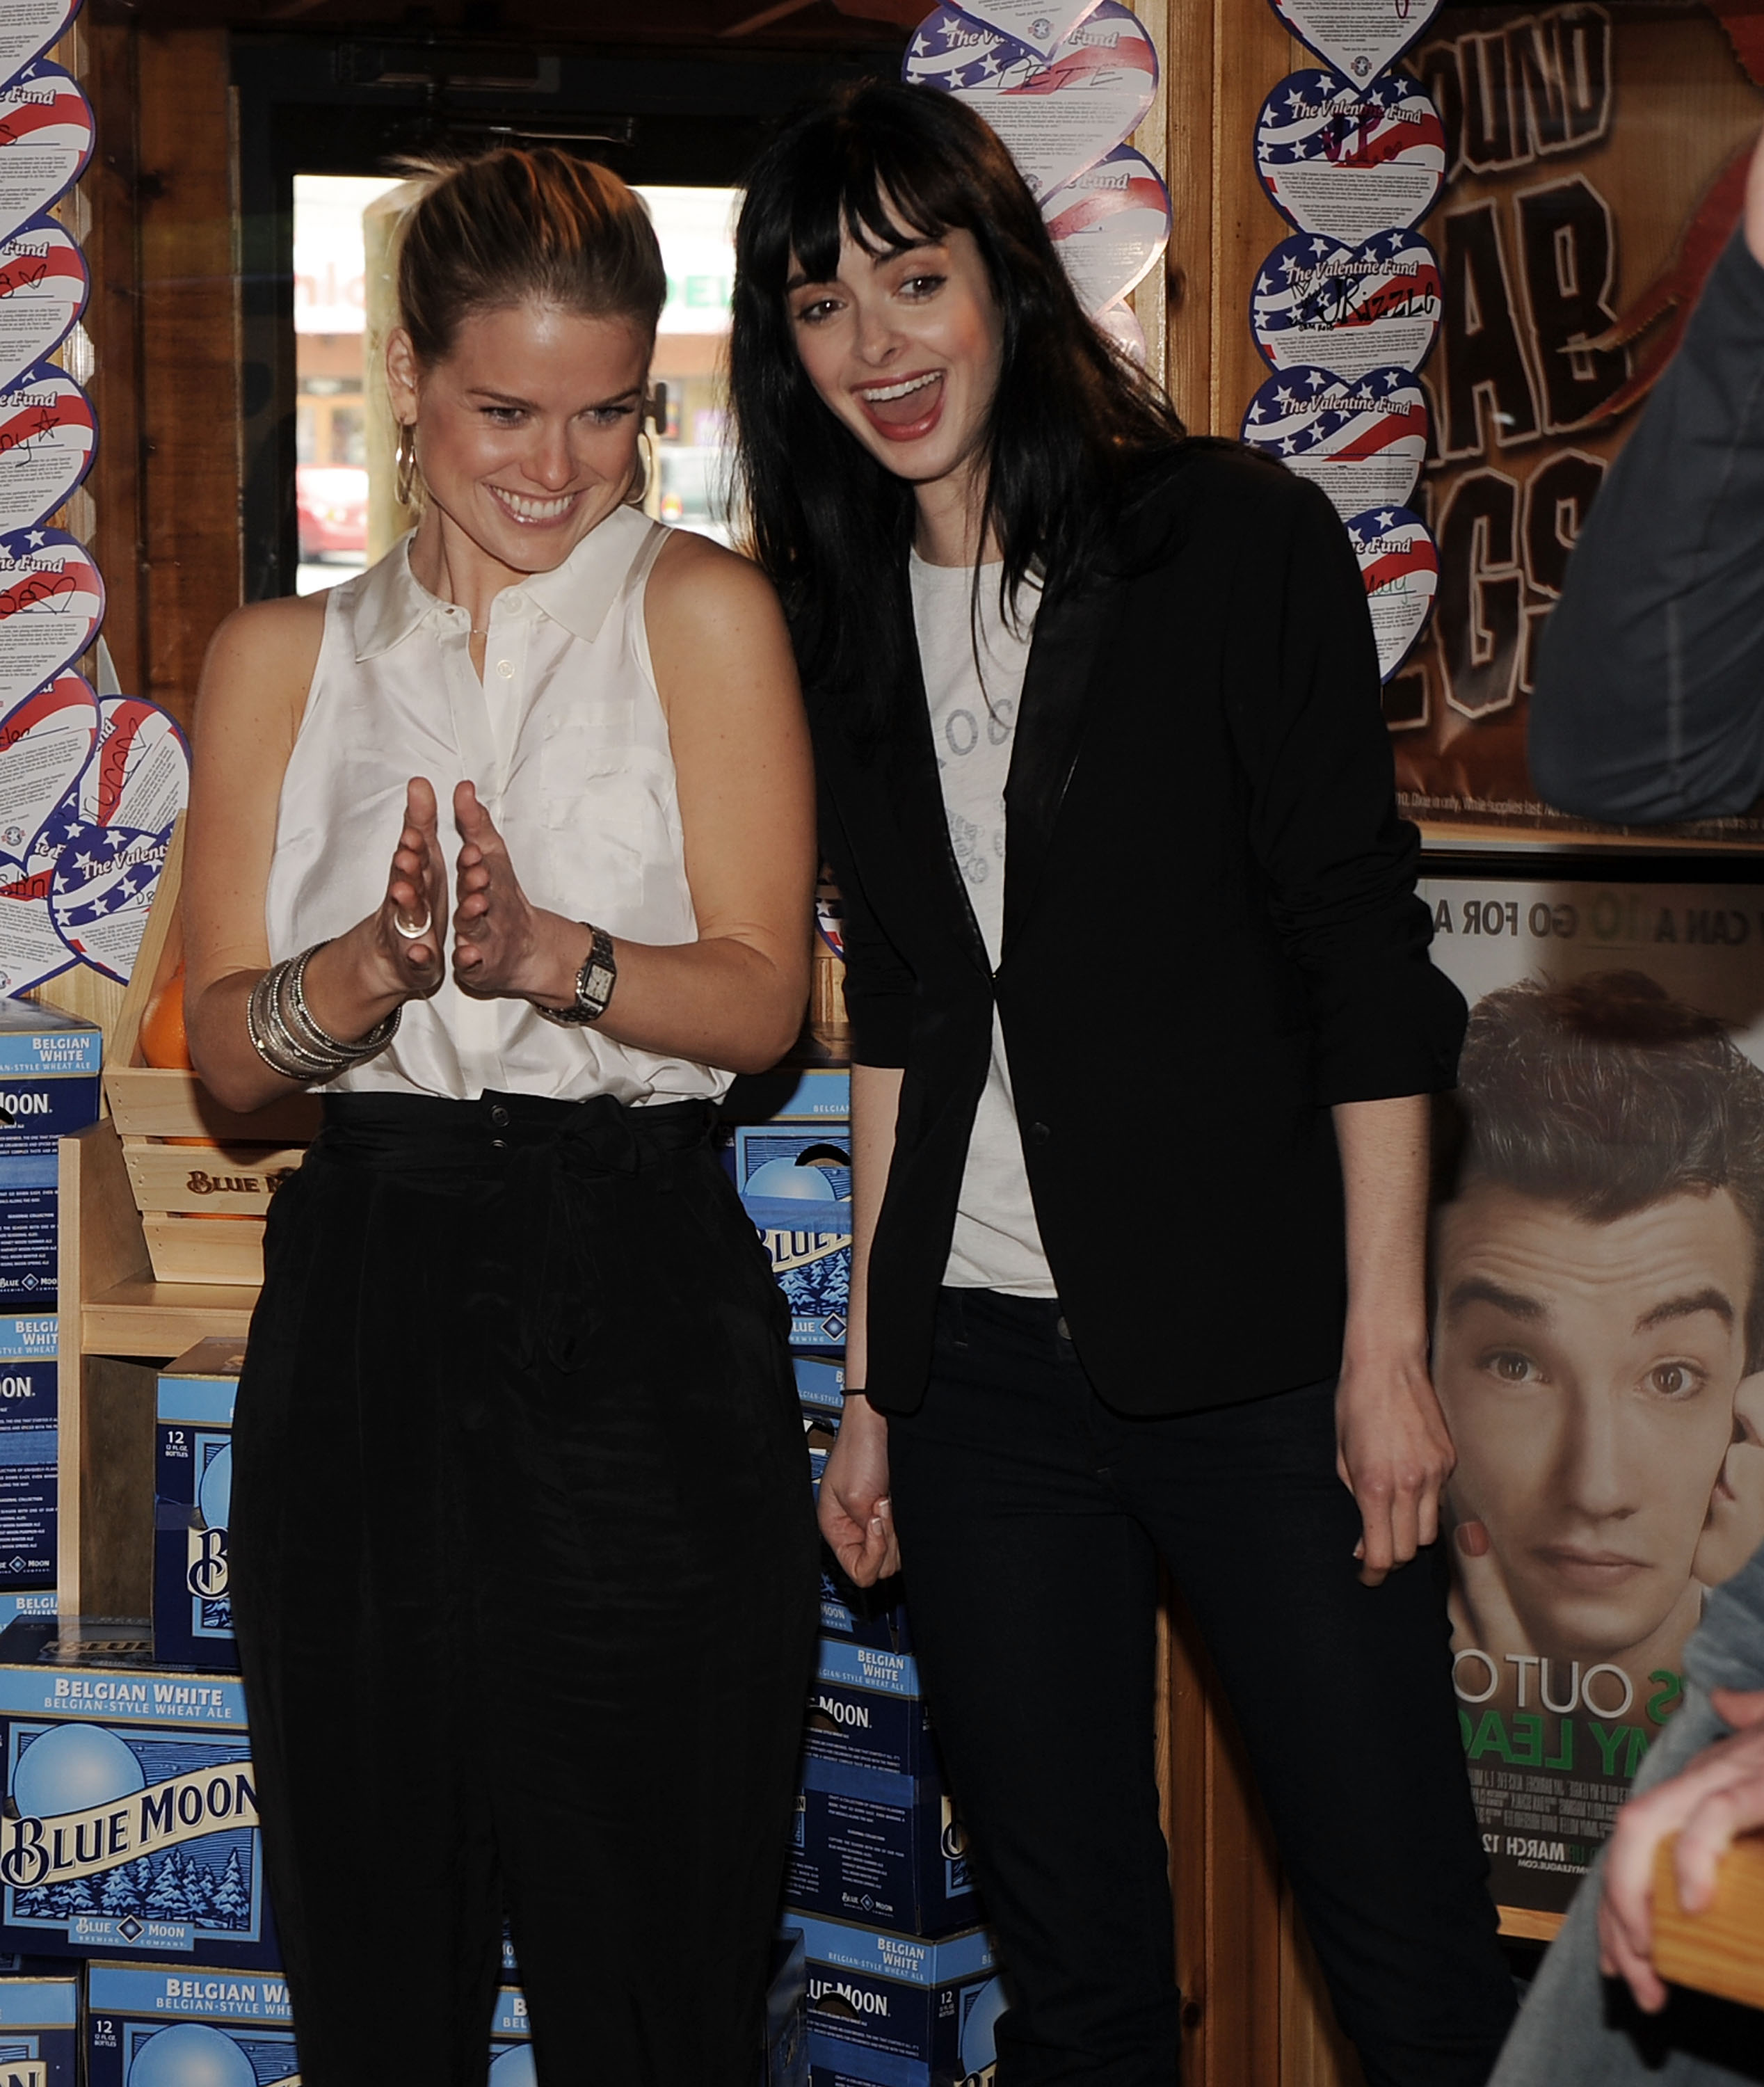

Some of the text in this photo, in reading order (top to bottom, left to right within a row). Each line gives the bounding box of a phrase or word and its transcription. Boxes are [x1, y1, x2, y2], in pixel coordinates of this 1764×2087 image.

[946, 30, 978, 48] The
[1068, 26, 1120, 49] Fund
[9, 85, 56, 106] Fund
[1292, 98, 1423, 126] The Valentine Fund
[3, 239, 49, 258] Fund
[1286, 257, 1420, 285] The Valentine Fund
[11, 389, 57, 408] Fund
[1280, 393, 1413, 416] The Valentine Fund
[1369, 536, 1413, 554] Fund
[19, 554, 65, 573] Fund
[82, 846, 169, 880] The Valent
[33, 1037, 90, 1050] BELGIAN
[40, 1050, 83, 1062] WHITE
[42, 1062, 72, 1071] WHEAT
[187, 1170, 261, 1195] BLUE
[40, 1277, 57, 1286] MOO
[793, 1322, 815, 1333] LUE
[22, 1333, 58, 1345] WHIT
[26, 1345, 55, 1354] WHEAT
[168, 1431, 184, 1444] 12
[857, 1649, 905, 1670] BELGIAN
[863, 1663, 899, 1682] WHITE
[55, 1677, 223, 1706] BELGIAN WHITE
[865, 1676, 889, 1688] WHEAT
[891, 1683, 904, 1692] ALE
[44, 1697, 232, 1719] BELGIAN-STYLE WHEAT ALE
[1, 1809, 130, 1889] BLUE
[76, 1917, 185, 1938] BLUE MOON
[878, 1937, 925, 1960] BELGIAN
[828, 1951, 883, 1972] BELGIAN-STYLE
[885, 1965, 908, 1977] WHEAT
[883, 1951, 919, 1972] WHITE
[166, 1977, 256, 2003] BELGIAN
[940, 1990, 954, 2005] 12
[156, 1997, 294, 2017] BELGIAN-STYLE WHE
[96, 2020, 113, 2034] 12
[503, 2017, 527, 2029] BEL
